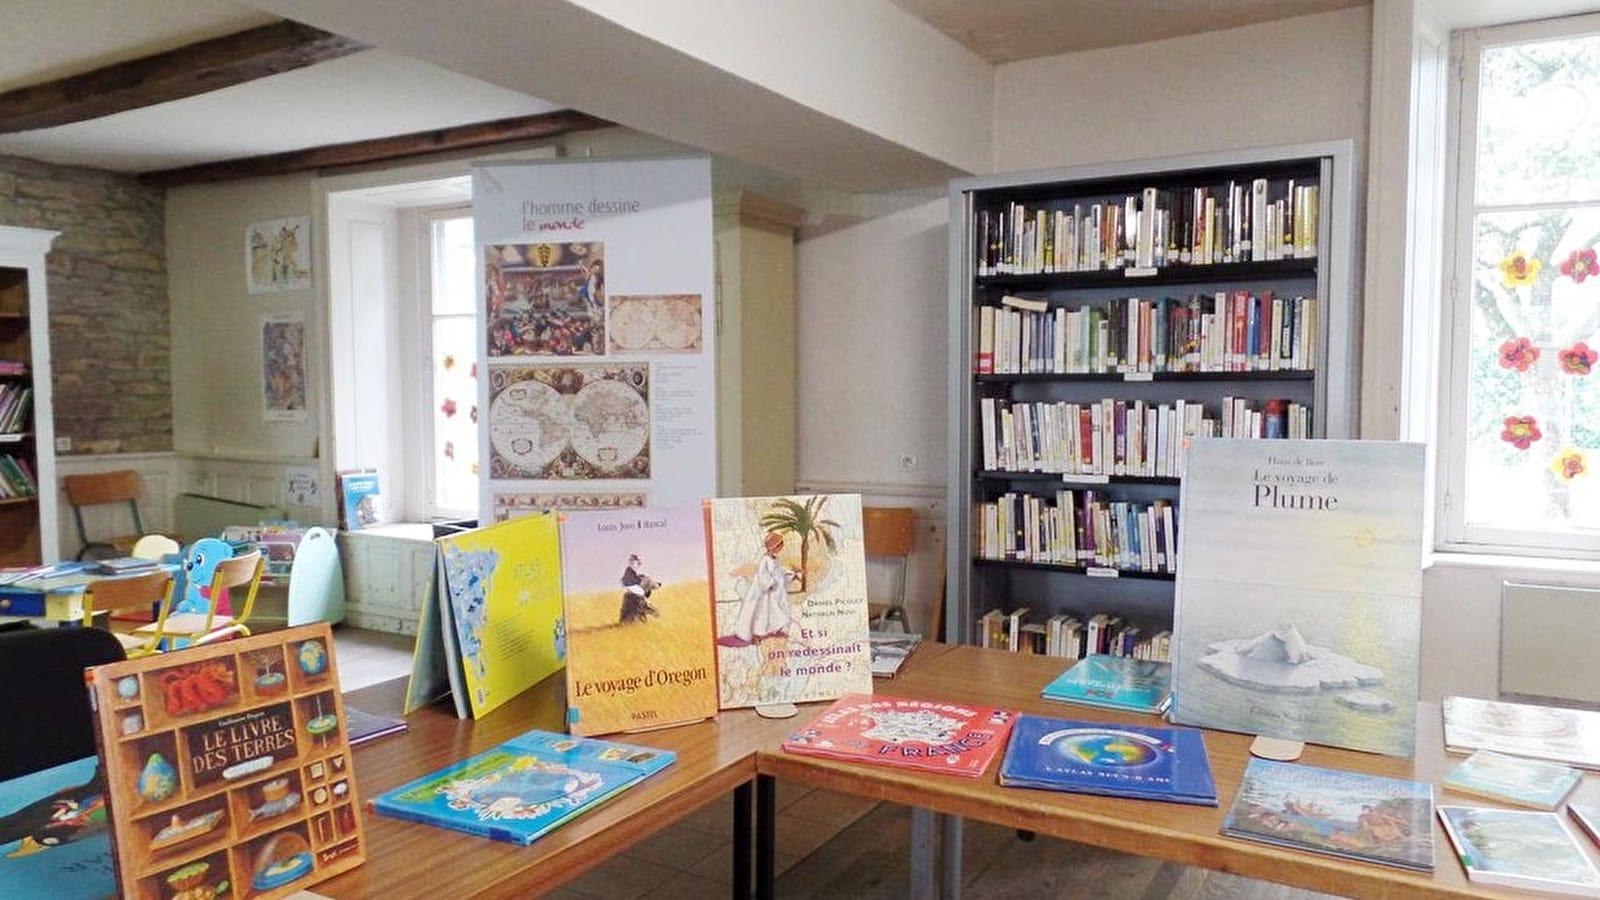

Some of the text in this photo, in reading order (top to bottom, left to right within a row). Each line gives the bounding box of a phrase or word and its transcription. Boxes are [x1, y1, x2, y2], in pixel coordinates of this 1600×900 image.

[523, 197, 640, 216] l'homme dessine
[523, 216, 536, 232] le
[1254, 469, 1339, 488] Le voyage de
[1254, 485, 1339, 512] Plume
[800, 627, 828, 639] Et si
[768, 642, 861, 660] on redessinait
[780, 667, 792, 677] le
[796, 662, 842, 675] monde
[575, 667, 707, 697] Le voyage d'Oregon
[203, 716, 282, 752] LE LIVRE
[192, 749, 228, 774] DES
[231, 729, 294, 761] TERRES
